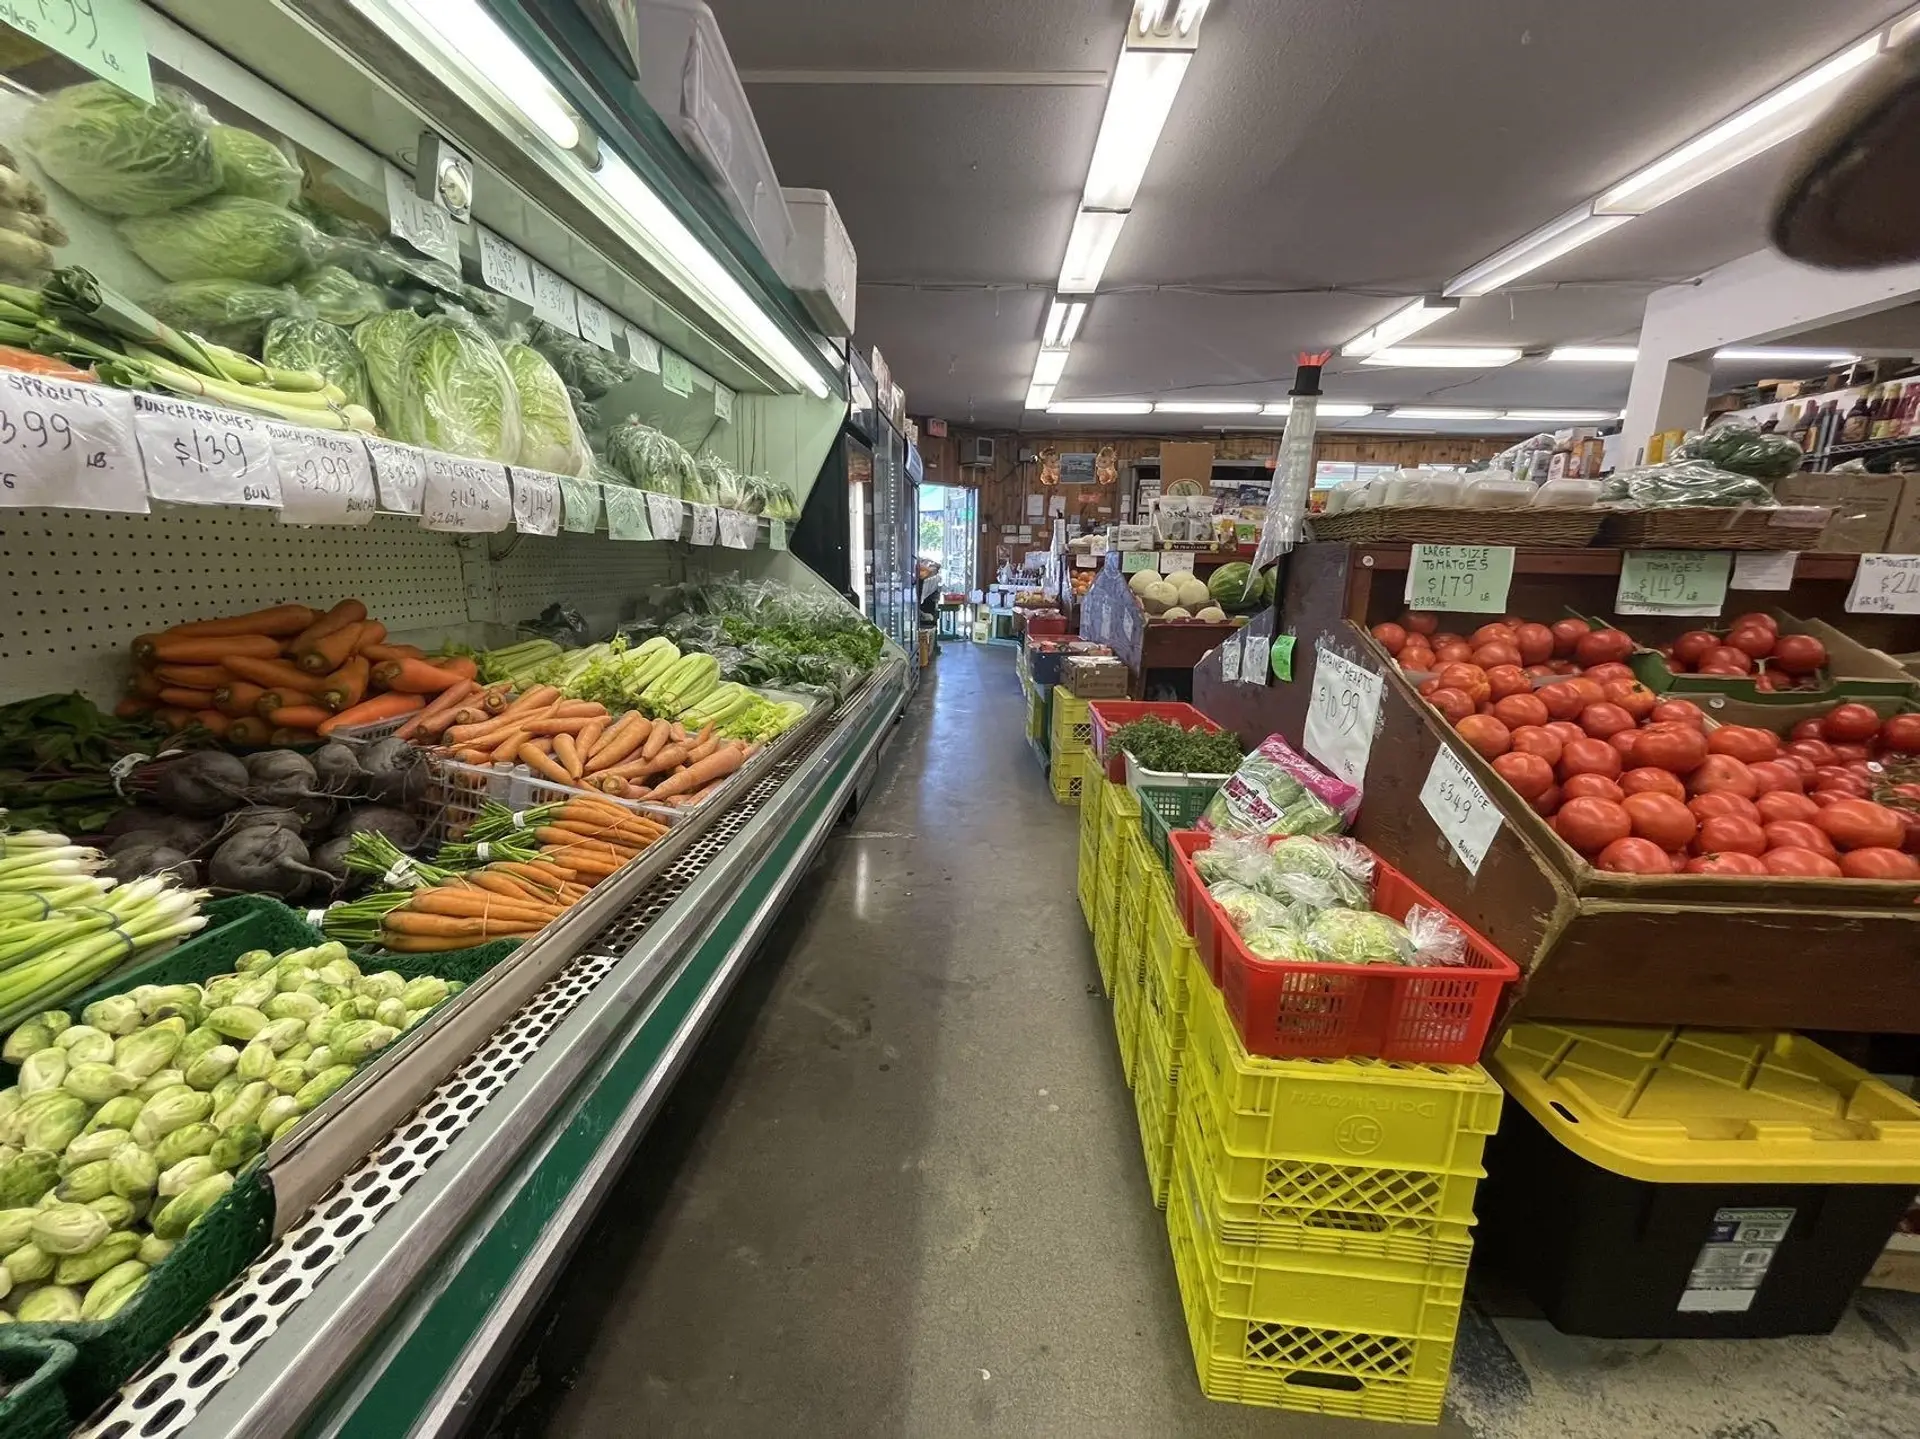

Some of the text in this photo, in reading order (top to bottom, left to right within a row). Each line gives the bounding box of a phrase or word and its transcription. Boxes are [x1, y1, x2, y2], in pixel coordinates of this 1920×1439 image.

[8, 374, 104, 407] SPROUTS
[134, 395, 187, 418] BUNCH
[243, 485, 271, 500] BUN
[1423, 546, 1490, 559] LARGE SIZE
[1422, 559, 1489, 571] TOMATOES
[1441, 746, 1491, 811] BUTTER LETTUCE
[1458, 840, 1479, 867] BUNCH
